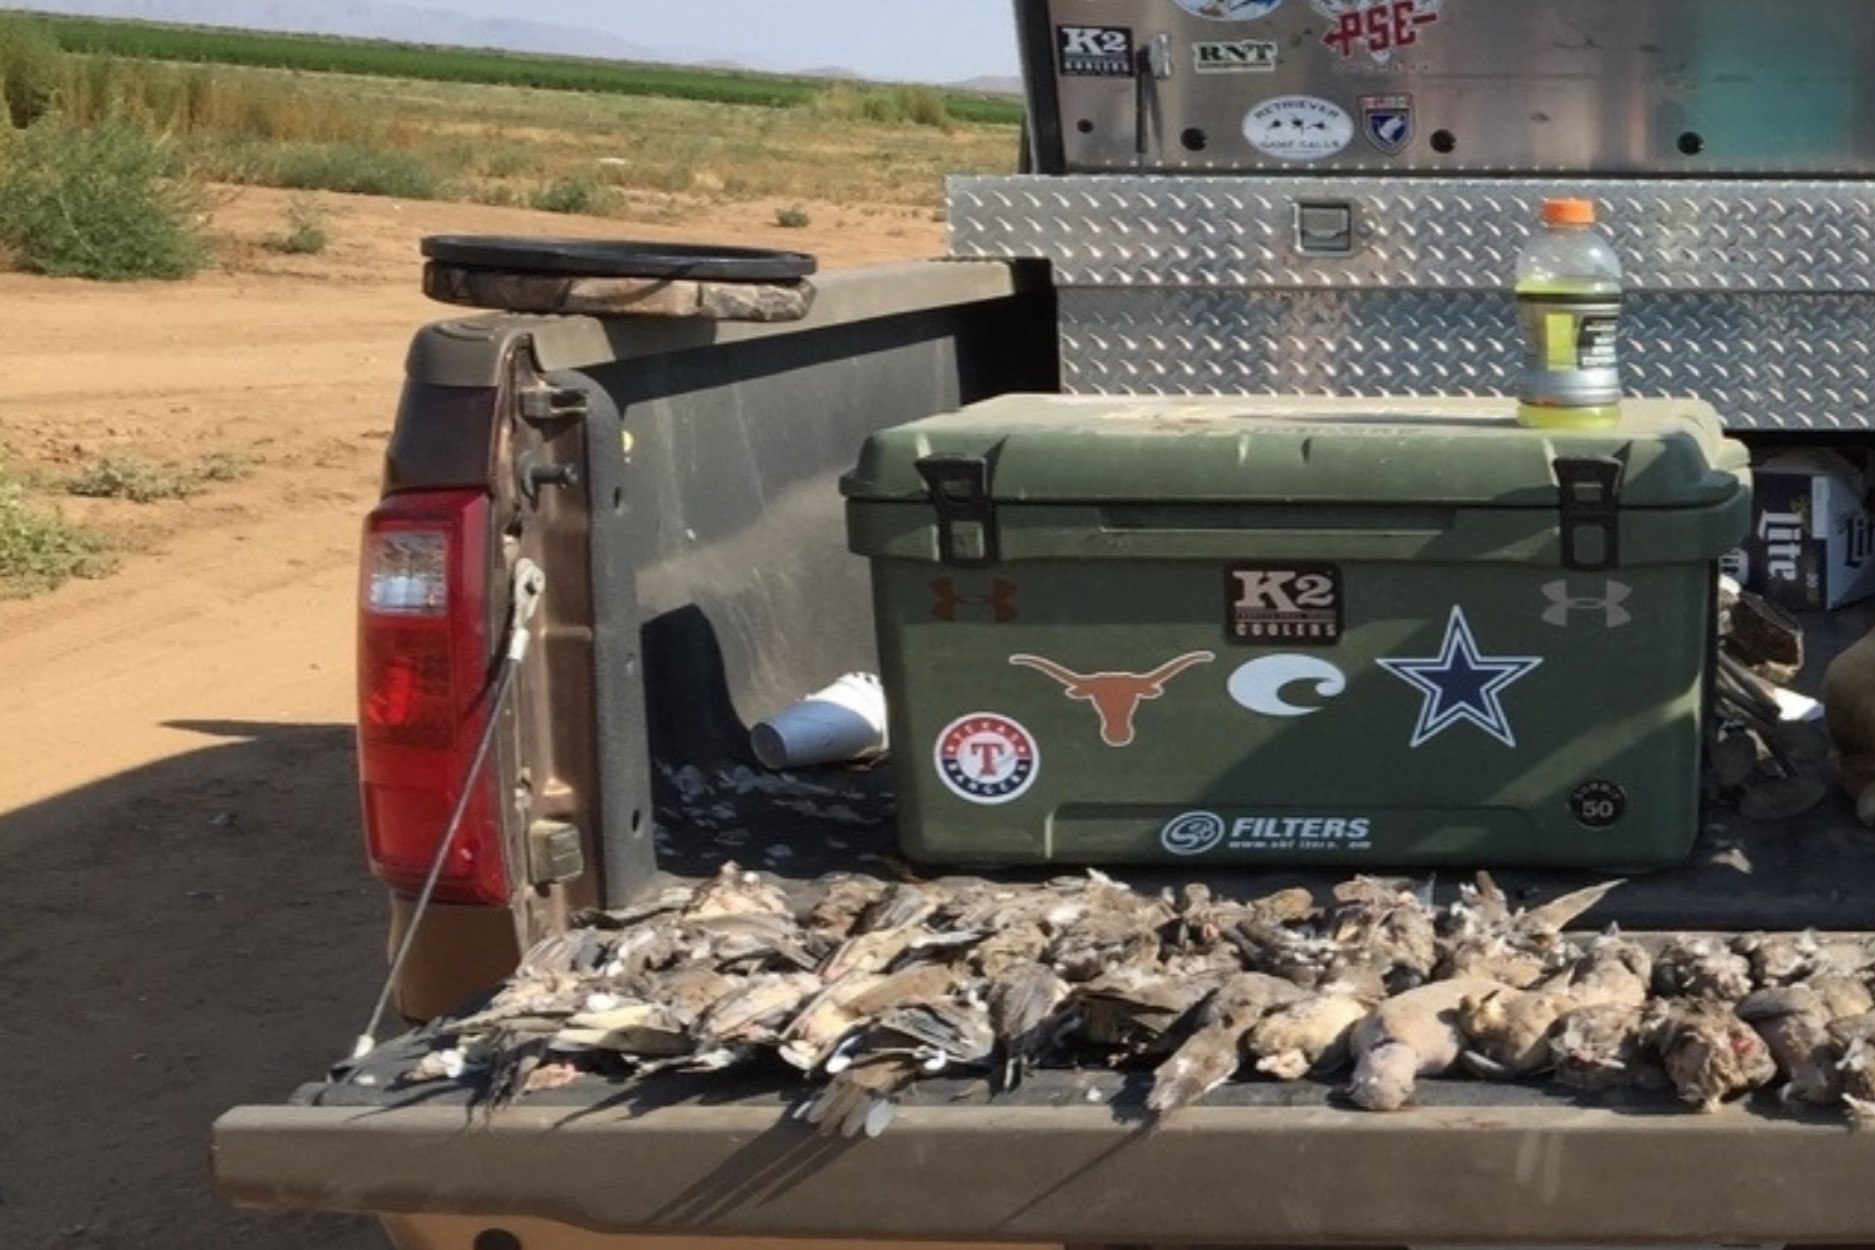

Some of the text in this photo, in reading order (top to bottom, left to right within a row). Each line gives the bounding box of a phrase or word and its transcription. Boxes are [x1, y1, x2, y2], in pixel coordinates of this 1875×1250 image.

[1330, 1, 1422, 55] PSE
[1062, 27, 1128, 56] K2
[1199, 43, 1273, 61] RNT
[1232, 571, 1334, 612] K2
[1235, 623, 1337, 637] COOLERS
[971, 743, 1004, 776] T
[1582, 801, 1614, 818] 50
[1230, 816, 1370, 839] FILTERS
